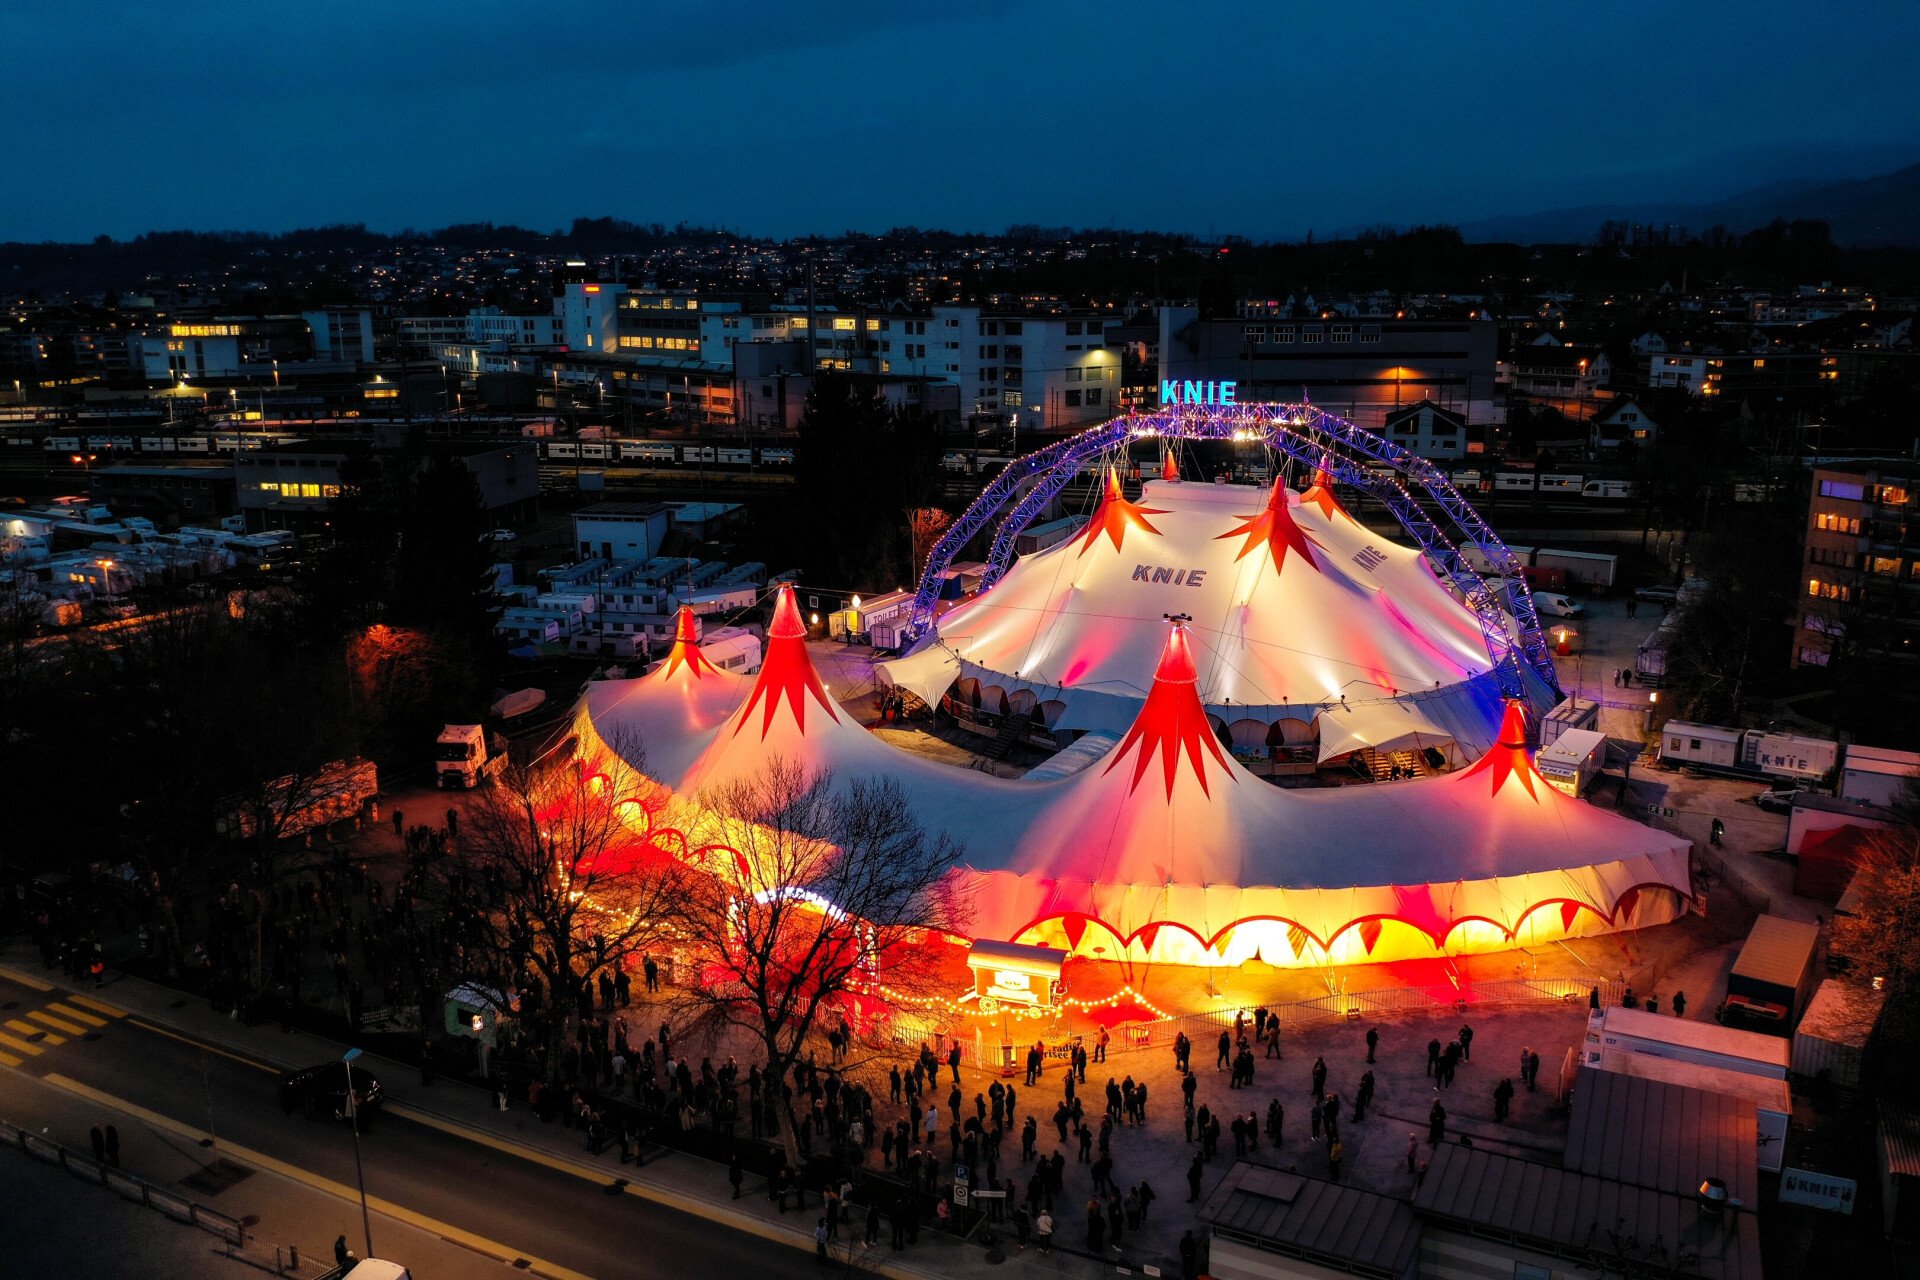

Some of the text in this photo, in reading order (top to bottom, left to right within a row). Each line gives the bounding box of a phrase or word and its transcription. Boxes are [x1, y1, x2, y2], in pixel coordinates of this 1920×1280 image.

[1161, 379, 1237, 406] KNIE
[1131, 564, 1207, 587] KNIE
[718, 598, 754, 610] KNIE
[1761, 753, 1808, 770] KNIE
[957, 1167, 965, 1177] P
[1798, 1179, 1840, 1198] KNIE
